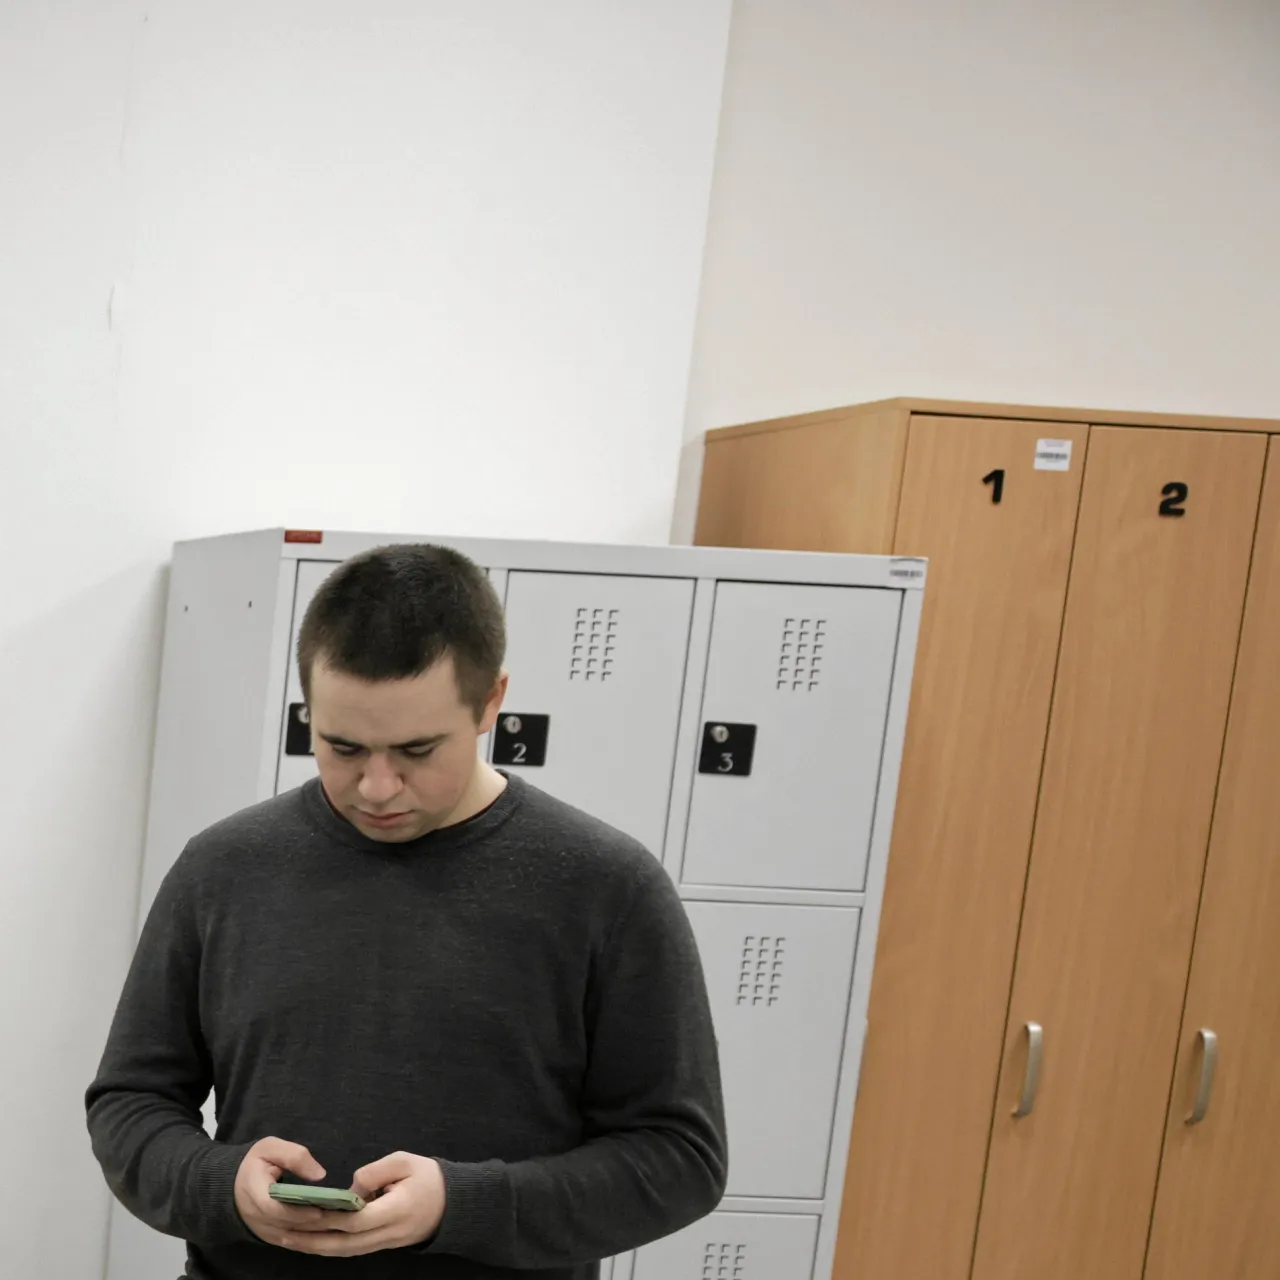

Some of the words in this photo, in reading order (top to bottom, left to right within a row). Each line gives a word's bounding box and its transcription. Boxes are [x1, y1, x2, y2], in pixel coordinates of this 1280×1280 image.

[982, 469, 1005, 505] 1
[1158, 482, 1188, 517] 2
[512, 742, 527, 763] 2
[718, 752, 733, 772] 3
